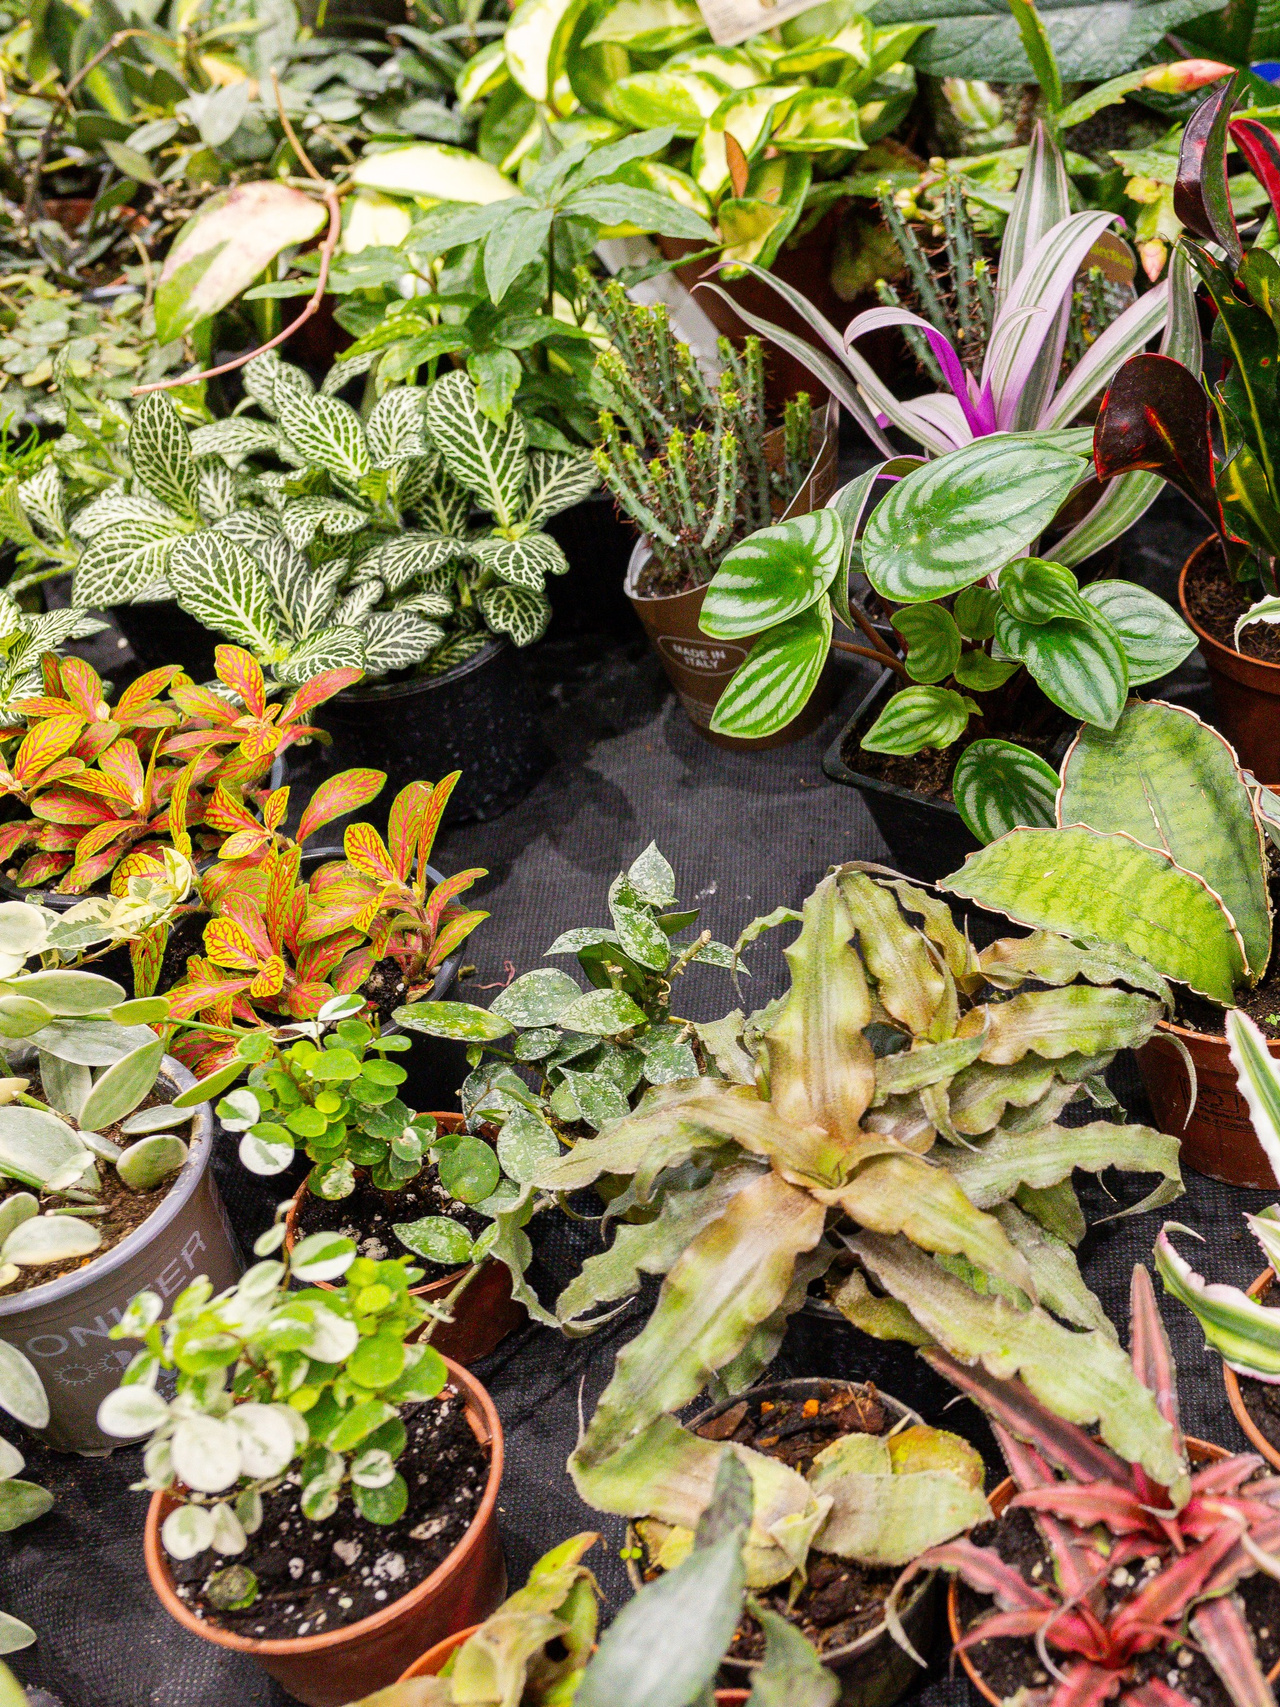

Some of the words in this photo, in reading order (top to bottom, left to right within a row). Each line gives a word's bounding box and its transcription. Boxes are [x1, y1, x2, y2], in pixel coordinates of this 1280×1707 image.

[672, 644, 708, 660] MADE
[710, 650, 726, 660] IN
[684, 656, 718, 669] ITALY
[26, 1230, 206, 1357] ONIER
